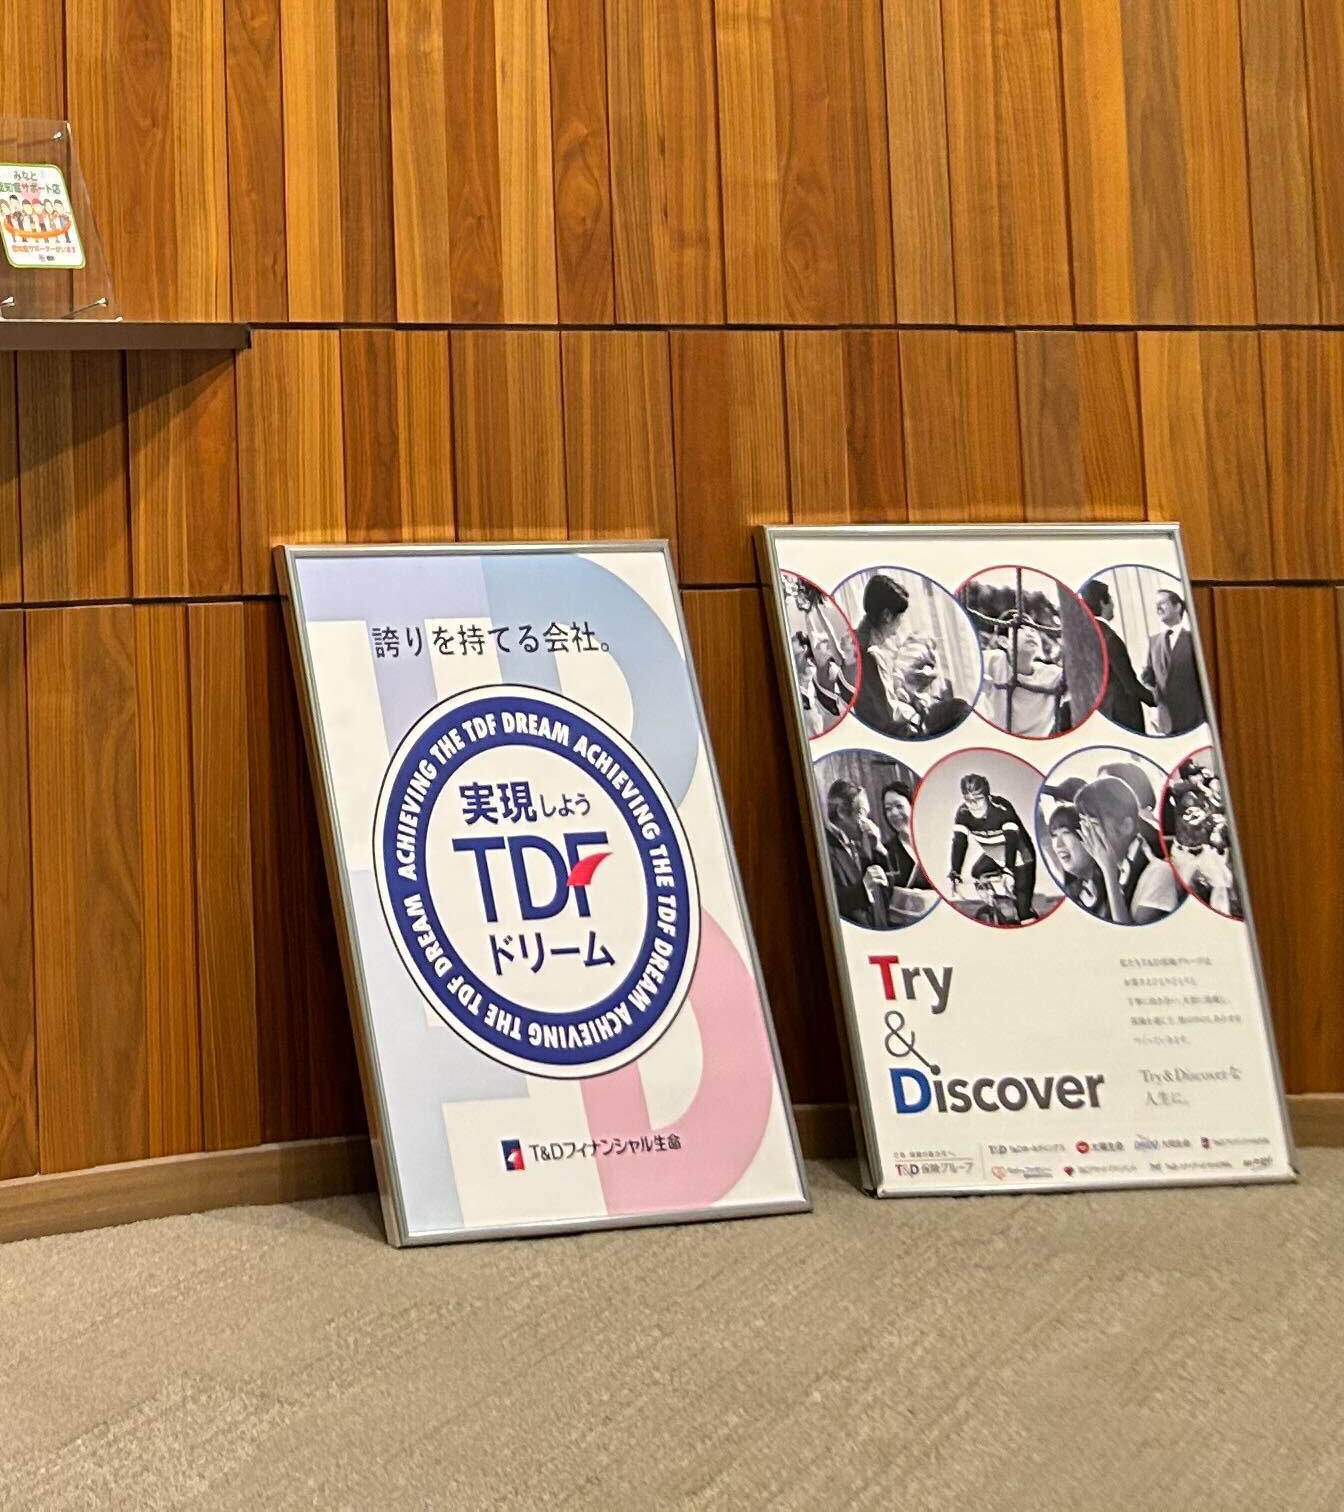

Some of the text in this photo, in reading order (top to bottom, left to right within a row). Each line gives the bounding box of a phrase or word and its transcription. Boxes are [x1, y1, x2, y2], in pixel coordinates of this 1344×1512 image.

[372, 621, 609, 658] 誇りを持てる会社。
[459, 781, 591, 825] 実現しよう
[396, 712, 677, 1049] ACHIEVING THE TDF DREAM ACHIEVING THE TDF DREAM ACHIEVING THE TDF DREAM
[452, 831, 613, 923] TDF
[489, 931, 616, 976] ドリーム
[868, 954, 954, 1014] Try
[883, 1010, 940, 1075] &
[889, 1067, 1105, 1114] Discover
[529, 1133, 682, 1162] T&Dフィナンシャル生命
